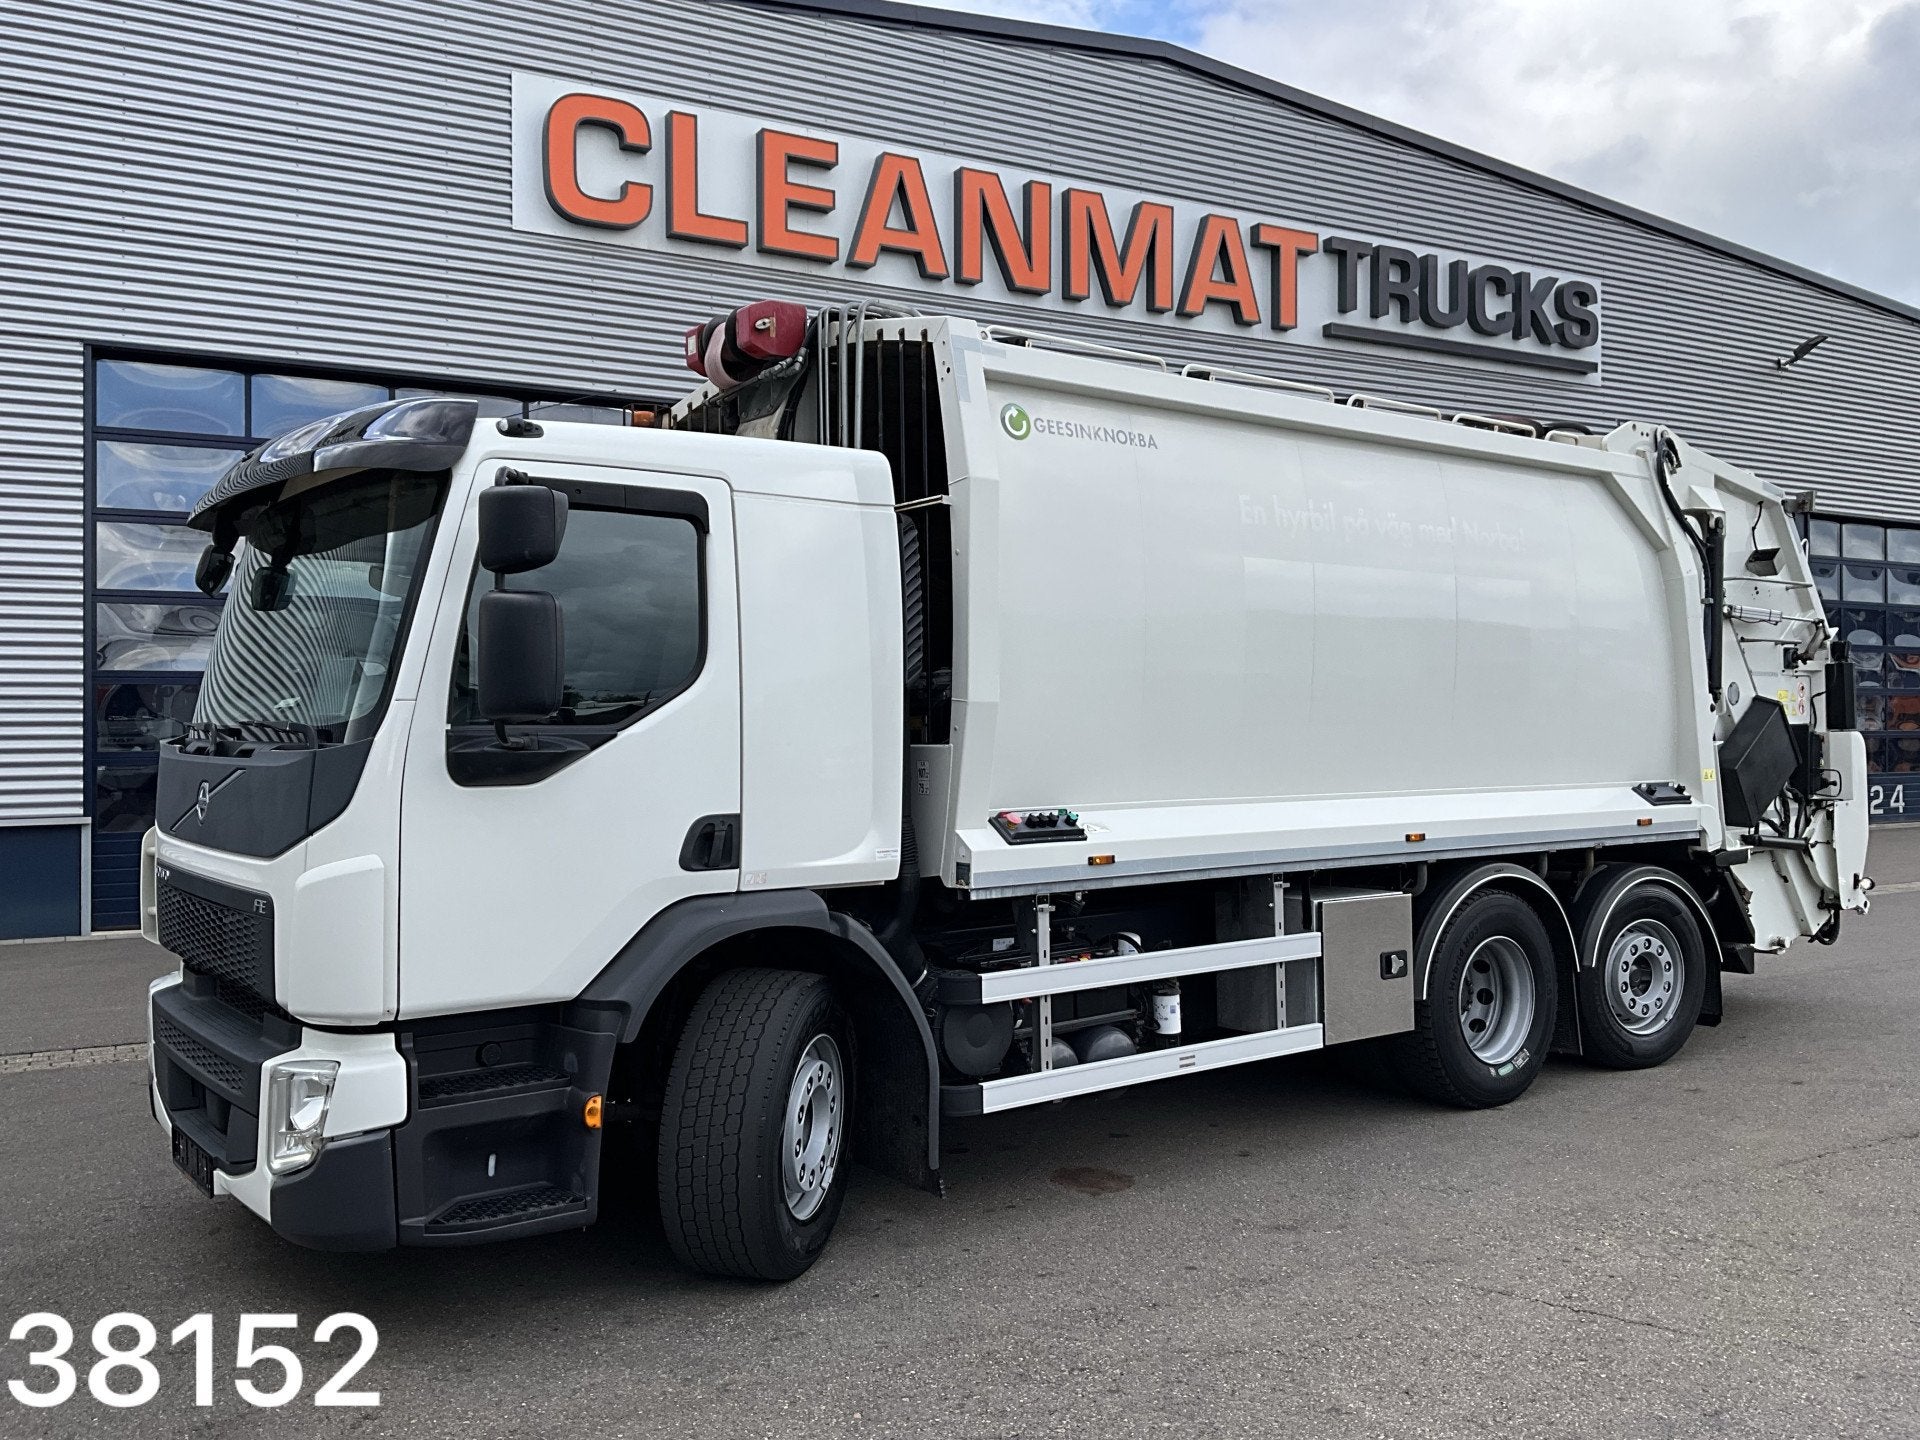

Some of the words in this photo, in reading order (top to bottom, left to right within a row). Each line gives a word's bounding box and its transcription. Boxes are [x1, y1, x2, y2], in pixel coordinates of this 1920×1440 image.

[542, 92, 1319, 331] CLEANMAT
[1323, 236, 1599, 350] TRUCKS
[1033, 417, 1159, 450] GEESINKNORBA
[1870, 784, 1905, 815] 24
